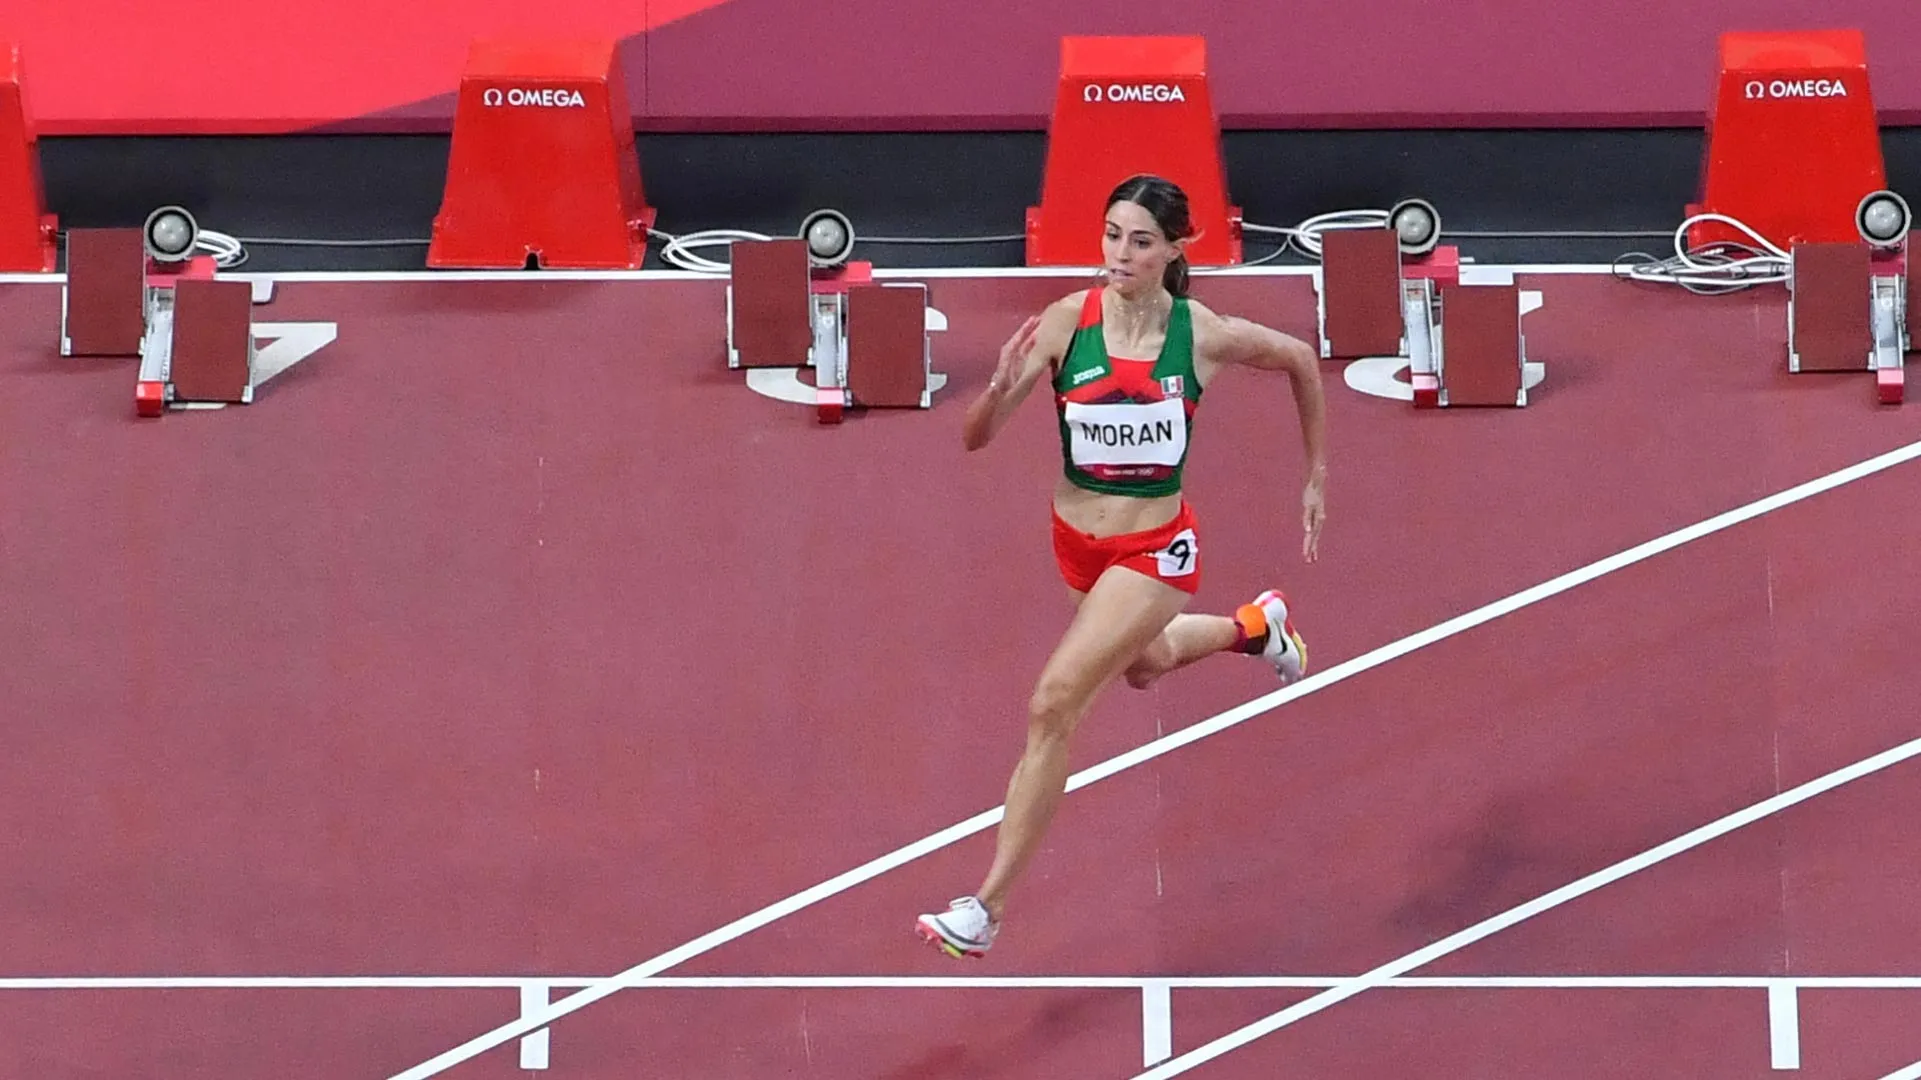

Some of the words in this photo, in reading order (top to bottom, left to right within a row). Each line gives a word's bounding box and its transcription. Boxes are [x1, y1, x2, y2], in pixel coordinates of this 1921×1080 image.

[507, 88, 586, 108] OMEGA
[1107, 84, 1186, 103] OMEGA
[1769, 79, 1847, 98] OMEGA
[1080, 419, 1173, 447] MORAN
[1167, 539, 1191, 571] 9
